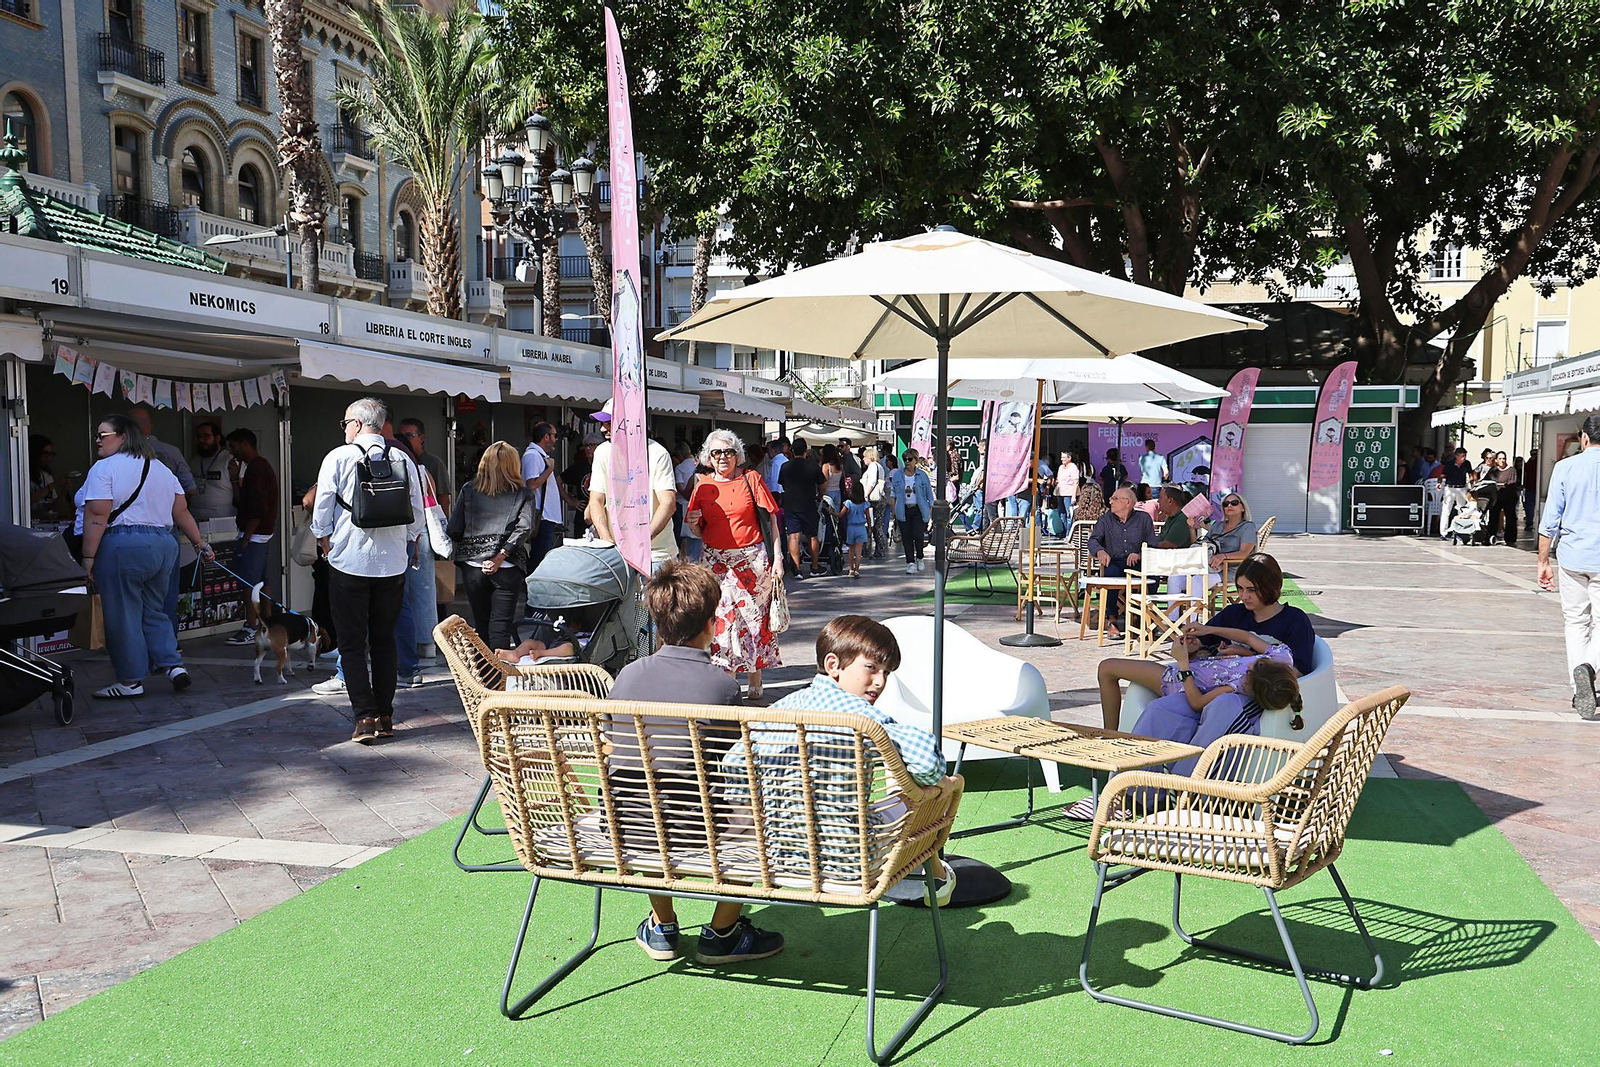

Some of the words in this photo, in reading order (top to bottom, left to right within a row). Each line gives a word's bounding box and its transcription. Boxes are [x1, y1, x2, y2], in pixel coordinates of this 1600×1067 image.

[51, 278, 69, 295] 19
[189, 291, 256, 315] NEKOMICS
[319, 322, 330, 335] 18
[366, 322, 404, 339] LIBRERIA
[407, 329, 417, 341] EL
[419, 331, 445, 345] CORTE
[447, 335, 472, 349] INGLES
[483, 348, 491, 358] 17
[522, 349, 548, 361] LIBRERIA
[551, 352, 573, 364] ANABEL
[595, 365, 600, 373] 16
[648, 369, 654, 377] DE
[654, 369, 668, 379] LIBROS
